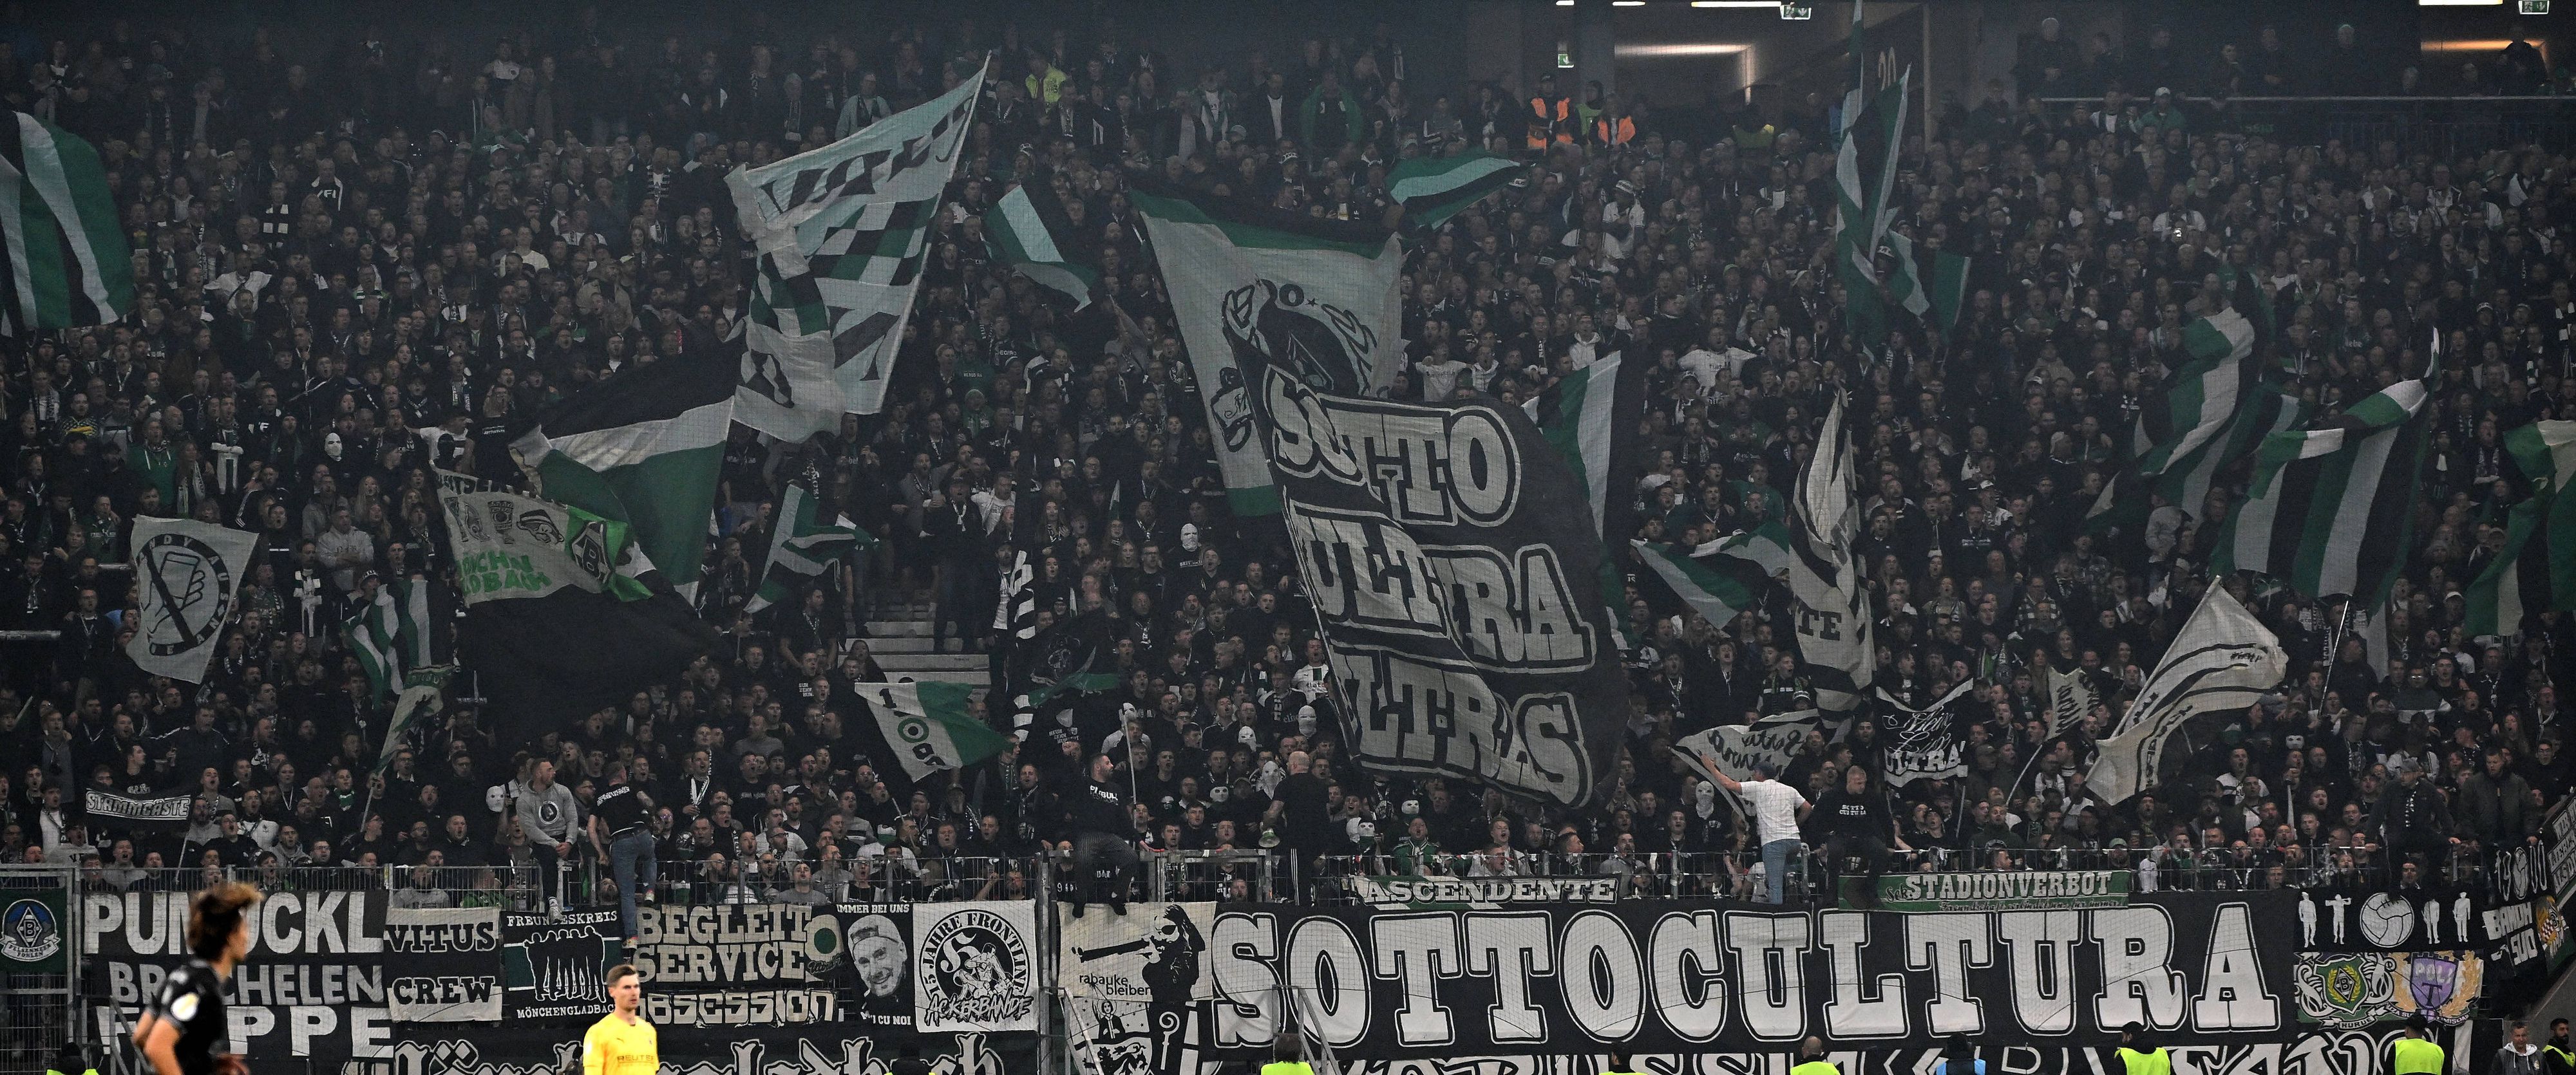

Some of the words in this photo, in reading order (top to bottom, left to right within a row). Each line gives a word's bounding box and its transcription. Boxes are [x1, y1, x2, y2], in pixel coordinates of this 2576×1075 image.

[1363, 878, 1618, 904] ASCENDENTE
[1905, 871, 2113, 900] STADIONVERBOT
[84, 891, 383, 955] PUMCKL
[507, 911, 618, 927] FREUNESKREIS
[871, 904, 887, 913] BEI
[890, 904, 910, 913] UNS
[386, 921, 497, 953] VITUS
[638, 904, 812, 945] BEGLEIT
[923, 916, 963, 969] JAHRE
[634, 942, 804, 983] SERVICE
[1212, 902, 2281, 1048] SOTTOCULTURA
[109, 965, 383, 1005] BRHELEN
[391, 976, 496, 1005] CREW
[1079, 973, 1128, 987] rabauke
[1106, 984, 1151, 996] bleiben
[516, 1003, 615, 1020] MÖNCHENGLADBAC
[878, 1015, 890, 1025] CU
[893, 1015, 911, 1025] NOI
